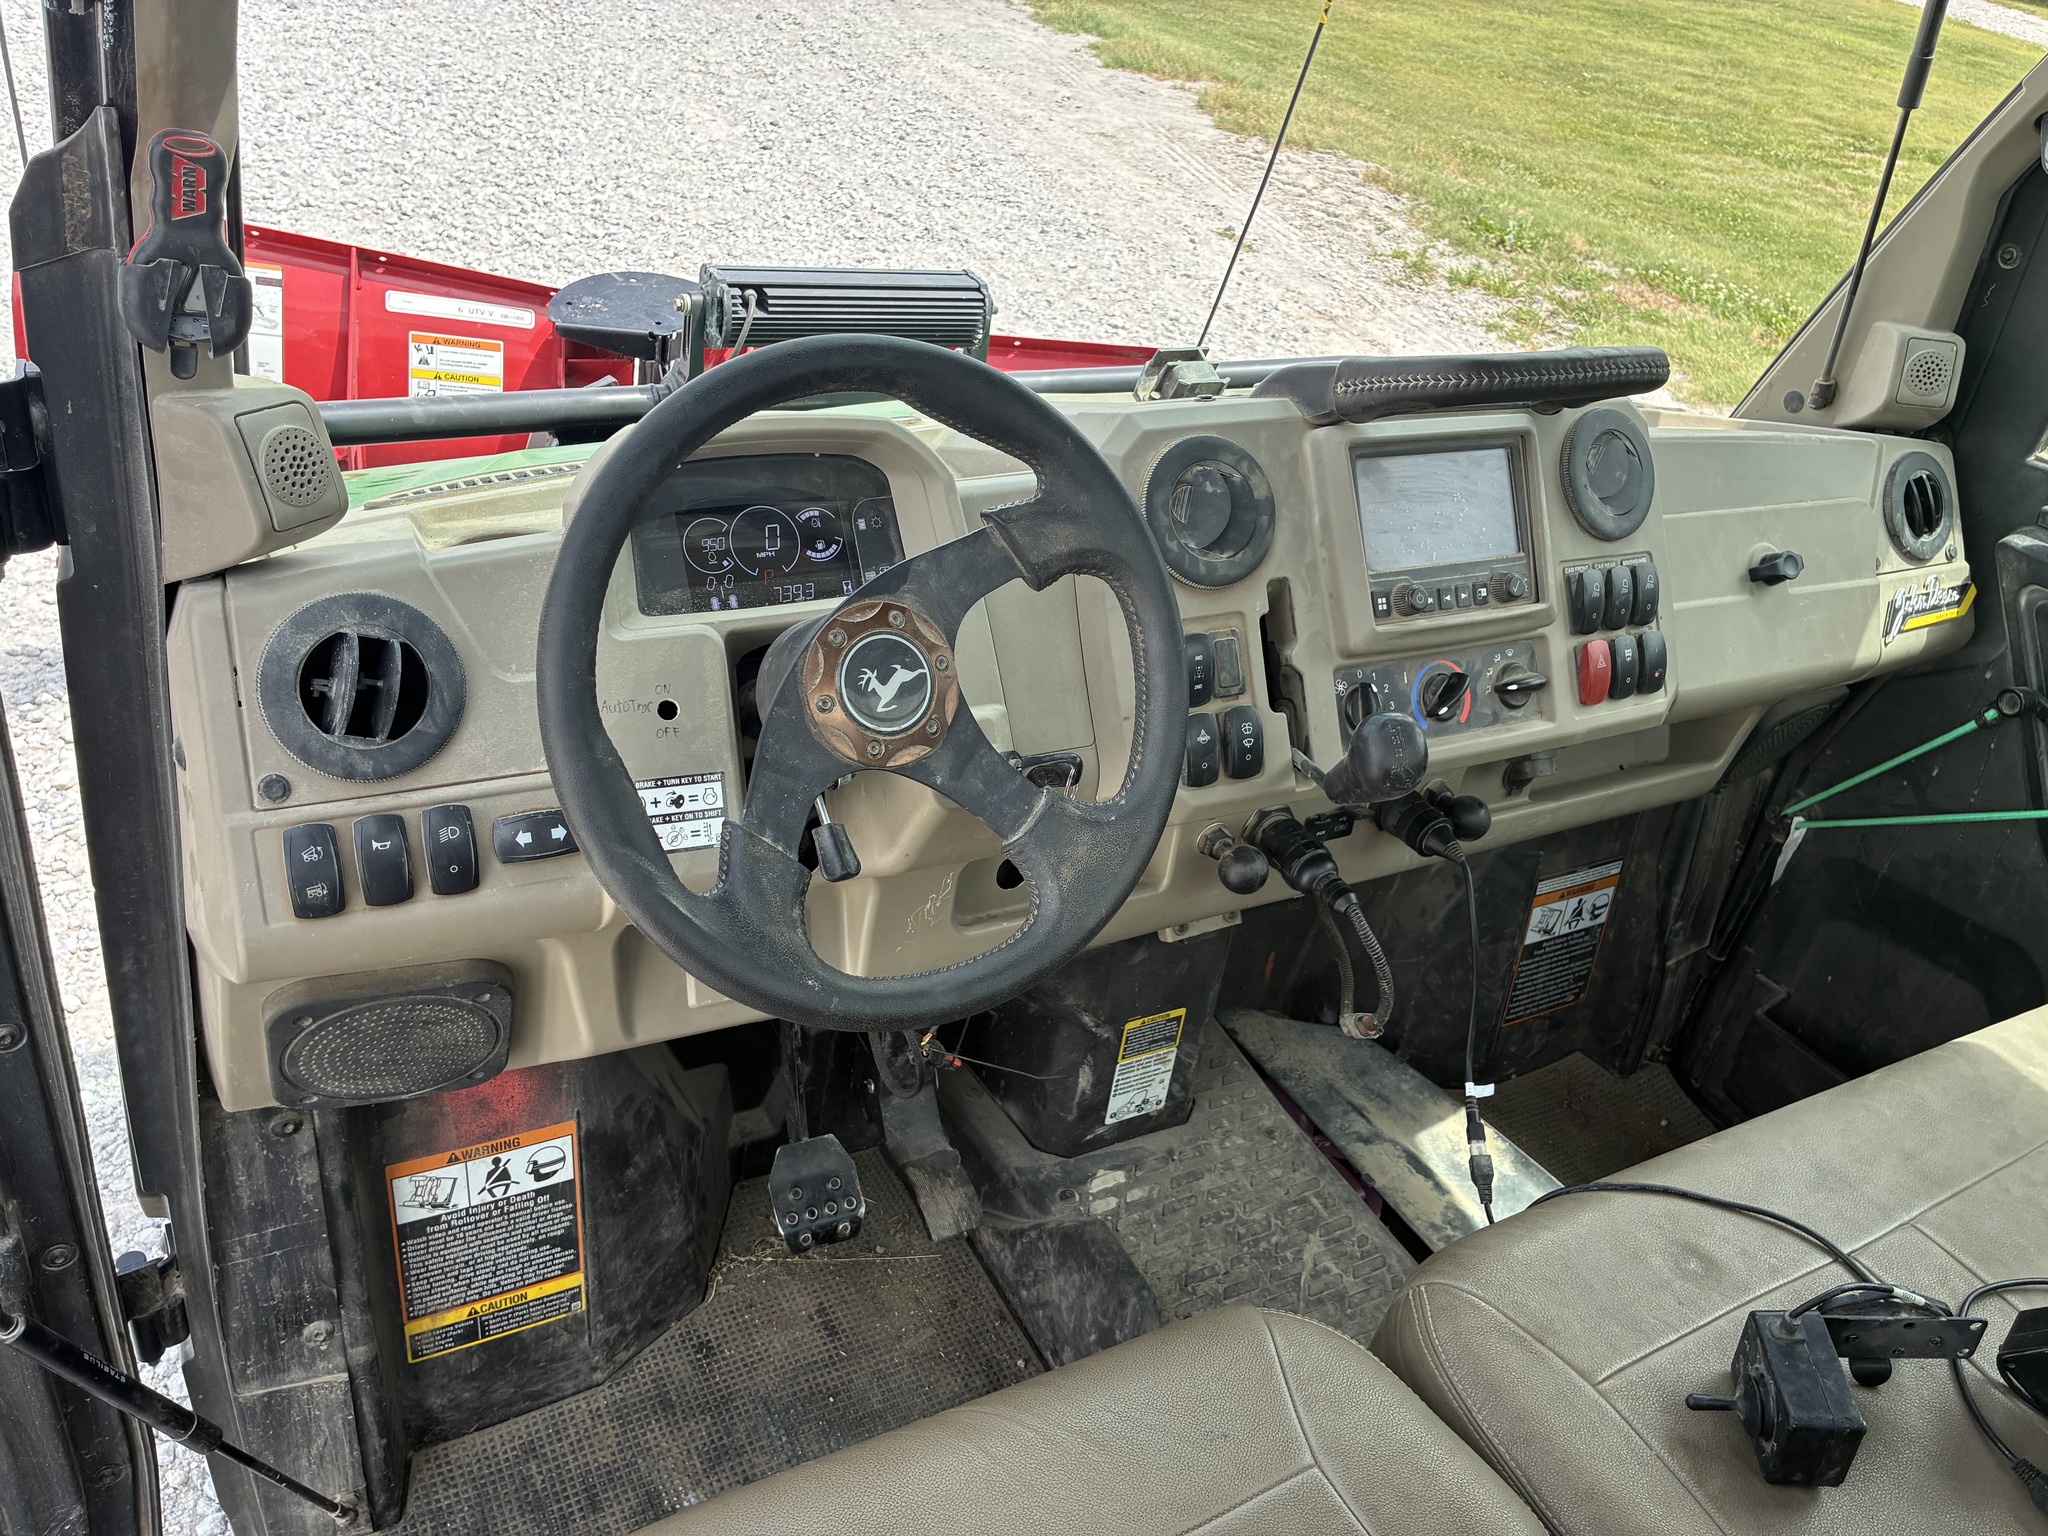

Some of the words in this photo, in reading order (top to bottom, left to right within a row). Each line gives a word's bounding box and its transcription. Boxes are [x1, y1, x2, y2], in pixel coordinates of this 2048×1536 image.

[182, 166, 197, 212] WARN
[468, 308, 485, 316] UTV
[444, 338, 481, 348] WARNING
[444, 373, 479, 382] CAUTION
[701, 537, 726, 552] 950
[756, 550, 776, 558] MPH
[764, 569, 774, 585] P
[655, 684, 672, 694] ON
[1384, 684, 1390, 693] 2
[1389, 701, 1395, 710] 3
[656, 727, 680, 739] OFF
[703, 774, 722, 782] START
[704, 810, 722, 818] SHIFT
[1147, 1013, 1170, 1024] CAUTION
[460, 1137, 521, 1160] WARNING
[441, 1210, 466, 1222] Avoid
[469, 1202, 495, 1216] Injury
[510, 1191, 535, 1204] Death
[427, 1222, 448, 1234] from
[451, 1211, 489, 1227] Rollover
[504, 1199, 534, 1214] Falling
[537, 1195, 550, 1204] Off
[480, 1292, 528, 1314] CAUTION
